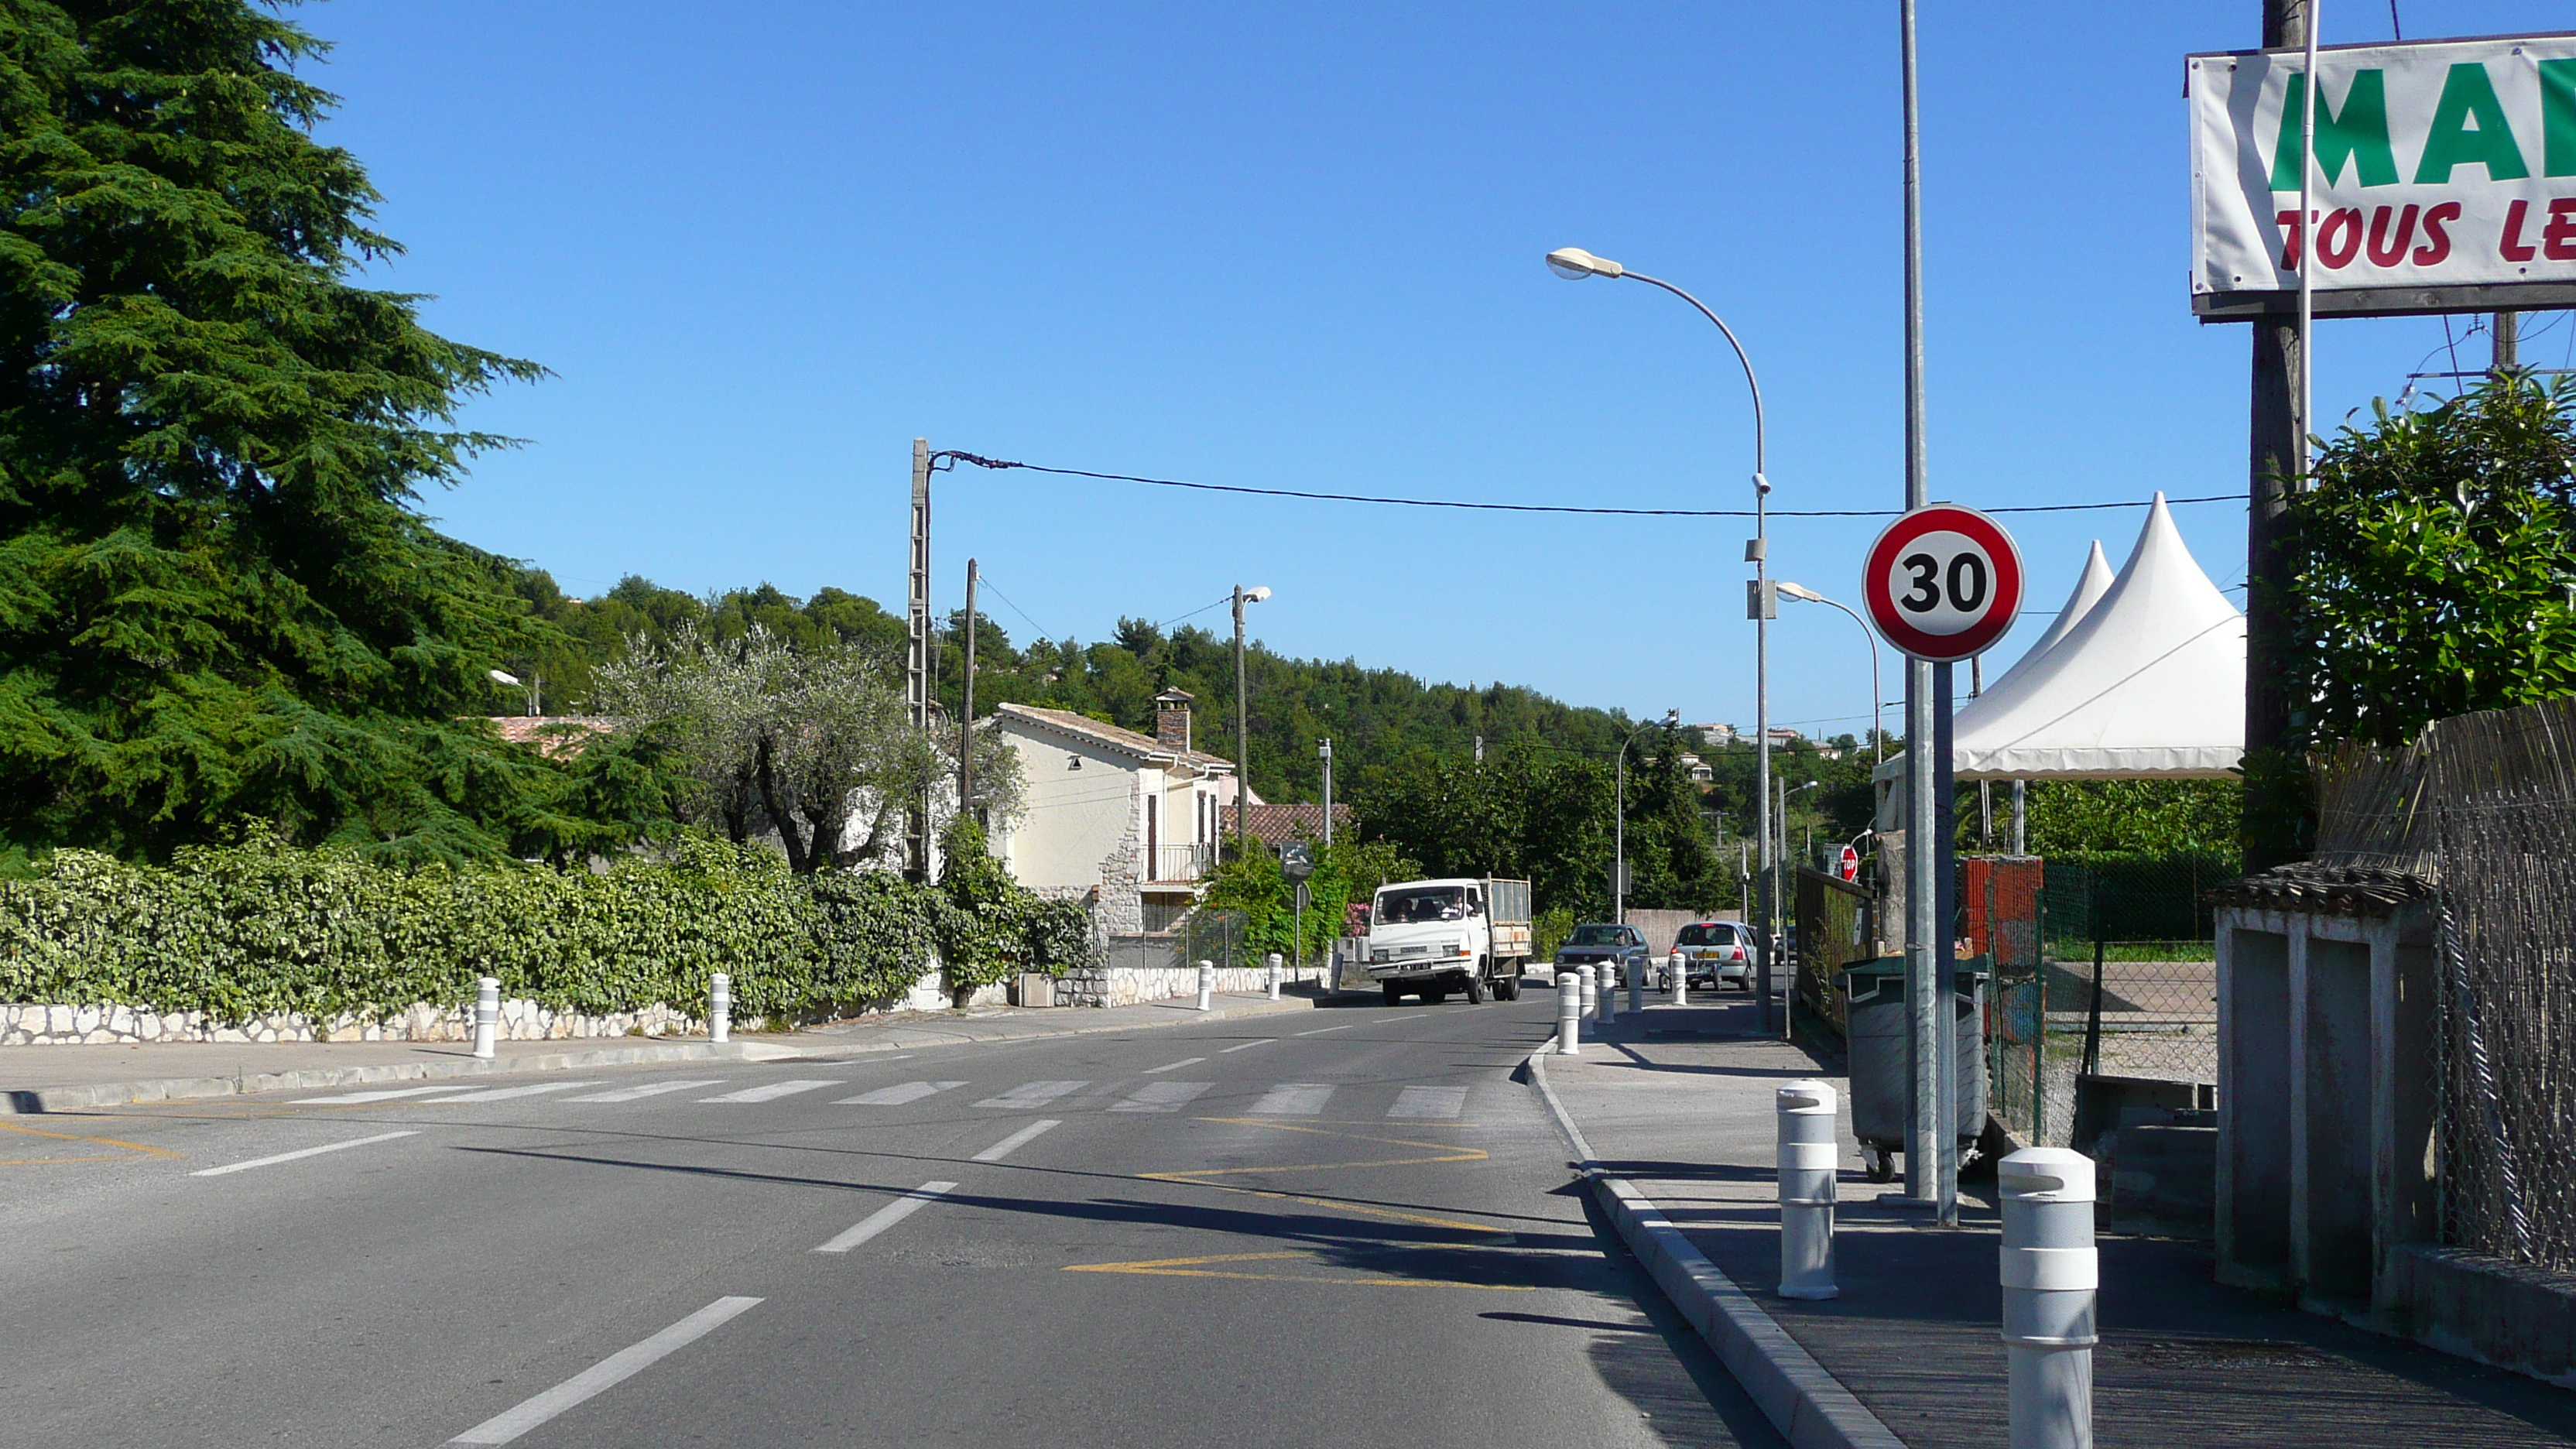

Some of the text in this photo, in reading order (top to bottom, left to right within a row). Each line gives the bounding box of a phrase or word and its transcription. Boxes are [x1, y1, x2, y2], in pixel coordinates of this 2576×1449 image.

[2276, 201, 2461, 272] TOUS
[1900, 552, 1987, 613] 30
[1841, 859, 1856, 871] TOP
